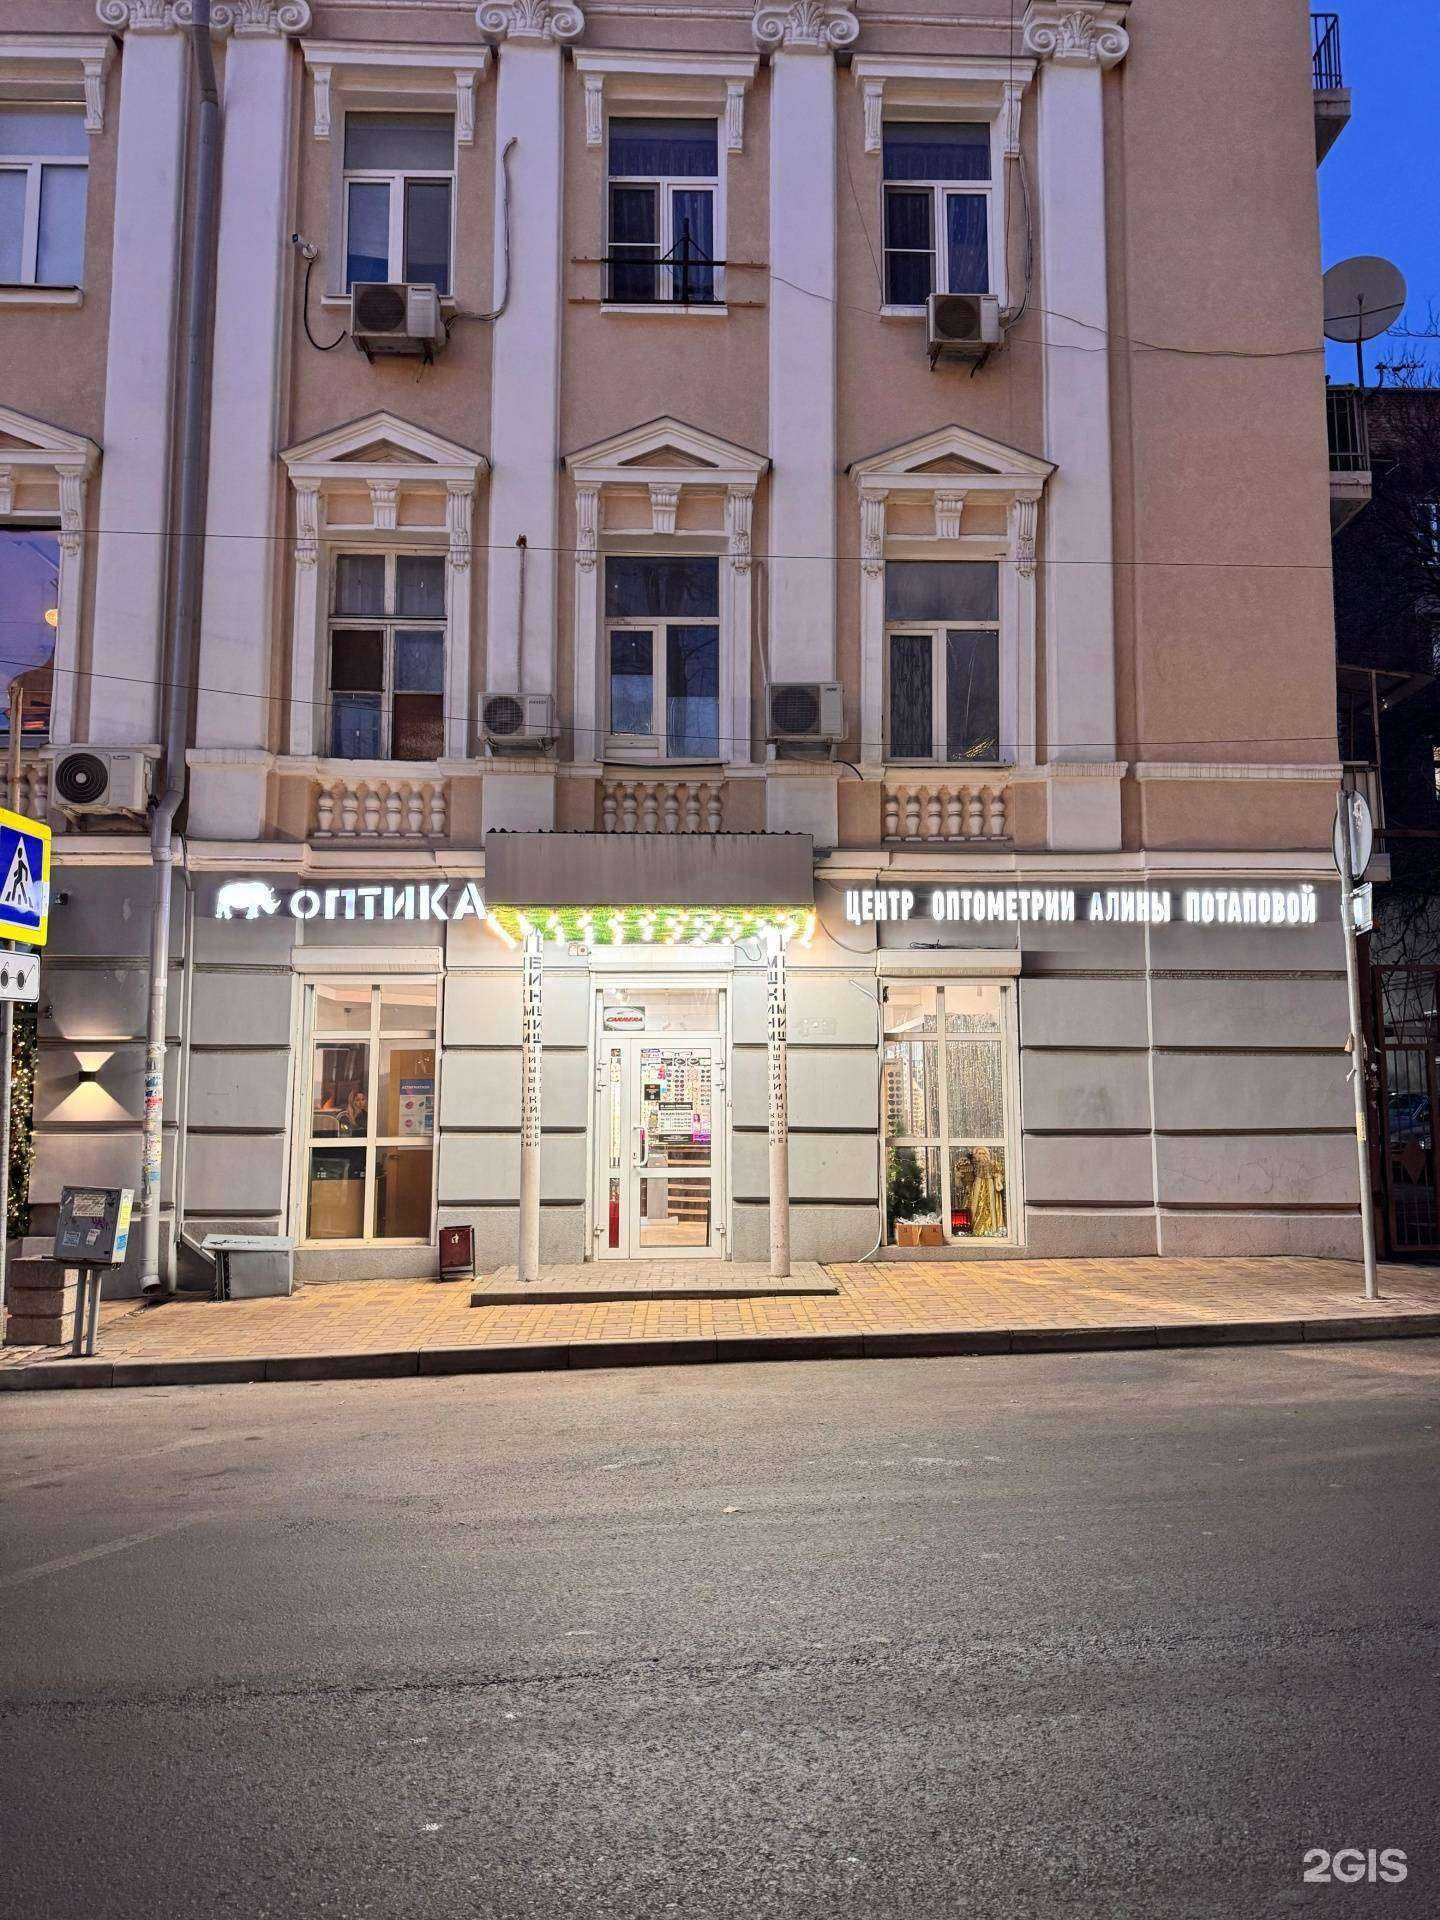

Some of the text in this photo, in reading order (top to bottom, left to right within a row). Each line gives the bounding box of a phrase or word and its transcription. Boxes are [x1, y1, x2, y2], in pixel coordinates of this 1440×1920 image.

[289, 883, 488, 921] ОПТИКА
[846, 884, 1317, 925] ЦЕНТР ОПТОМЕТРИИ АЛИНЫ ПОТАПОВОЙ
